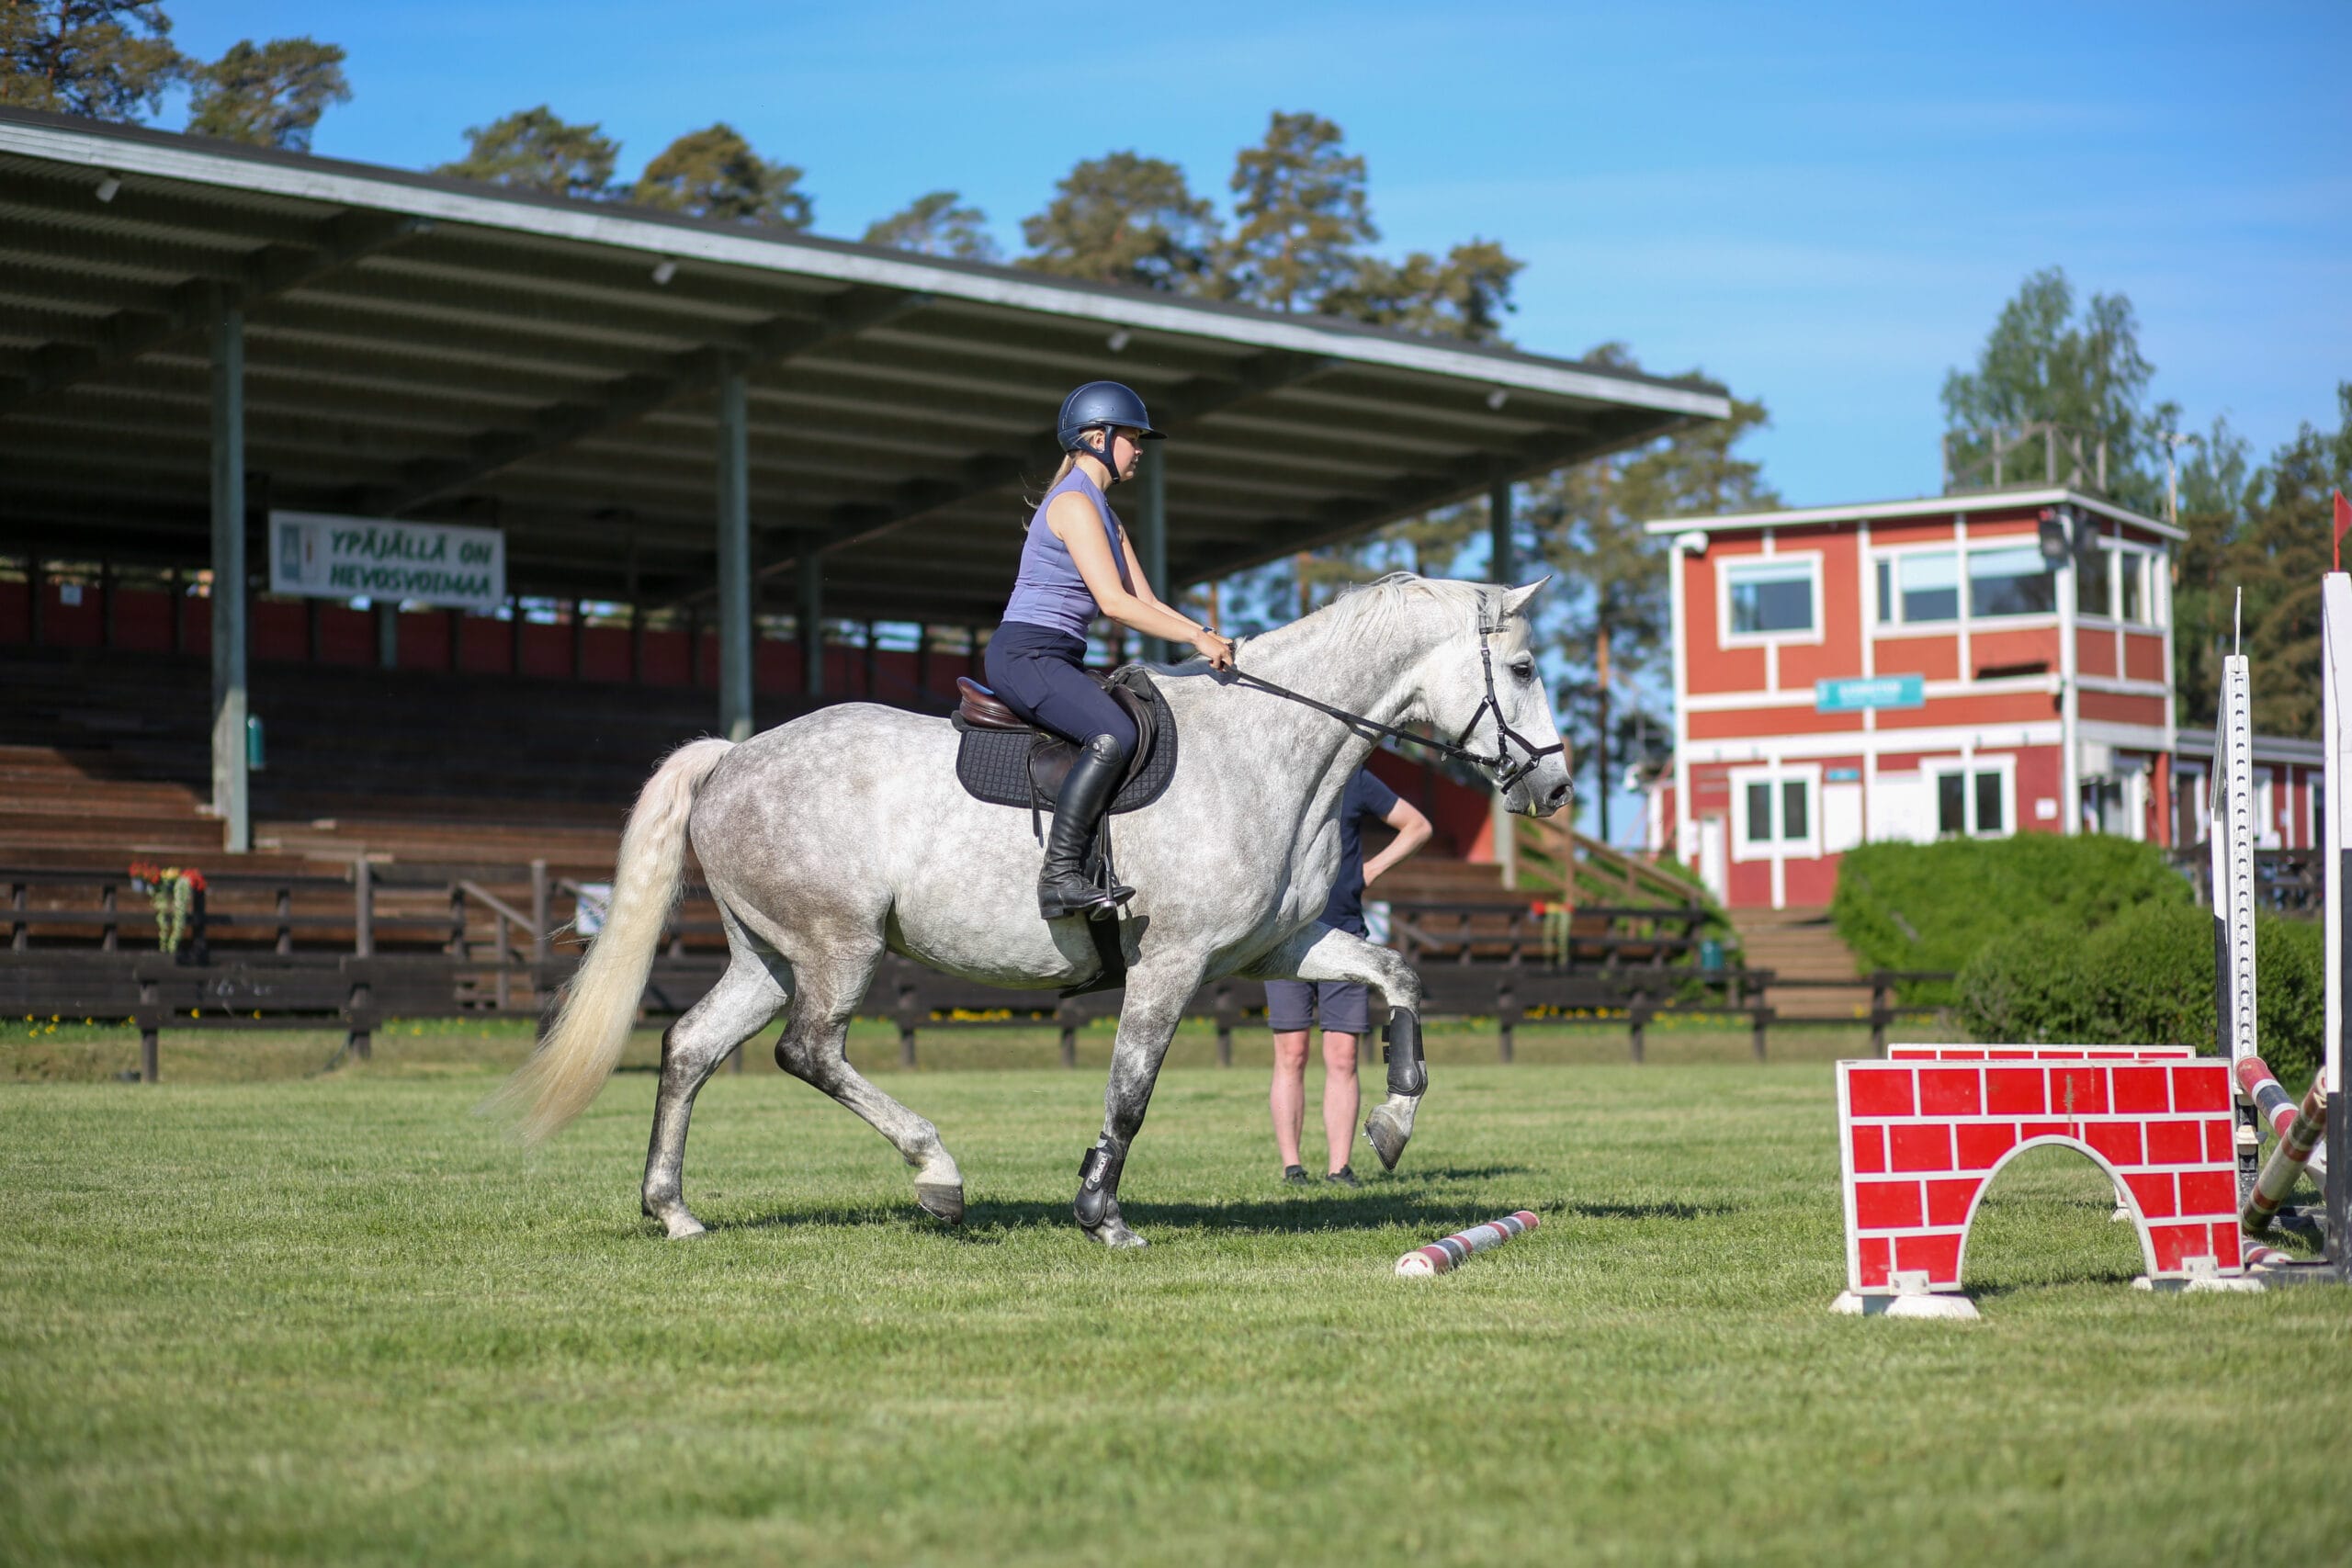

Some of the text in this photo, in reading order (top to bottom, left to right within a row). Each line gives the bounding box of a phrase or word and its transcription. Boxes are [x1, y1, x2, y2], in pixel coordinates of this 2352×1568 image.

[331, 527, 493, 565] YPÄJÄLLÄ ON
[330, 564, 492, 597] HEVOSVOIMAA
